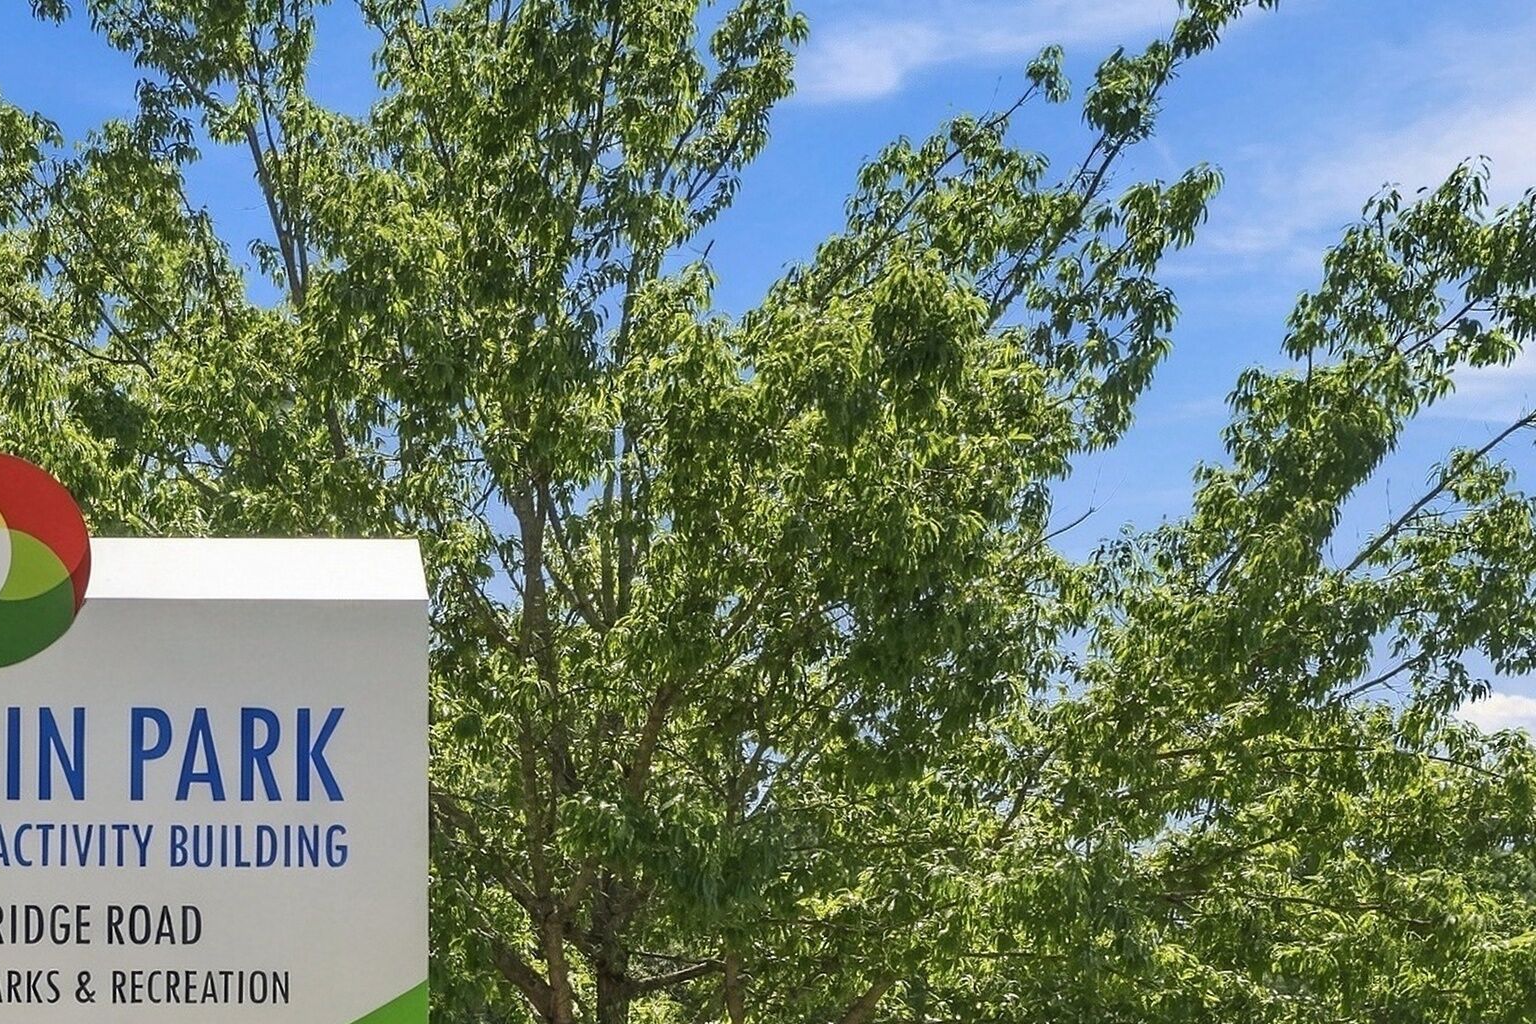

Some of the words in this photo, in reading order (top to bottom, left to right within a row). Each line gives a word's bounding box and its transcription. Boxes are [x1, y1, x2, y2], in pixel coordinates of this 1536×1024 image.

[130, 706, 345, 802] PARK
[169, 824, 348, 868] BUILDING
[107, 904, 202, 945] ROAD
[74, 970, 96, 1004] &
[112, 970, 289, 1004] RECREATION
